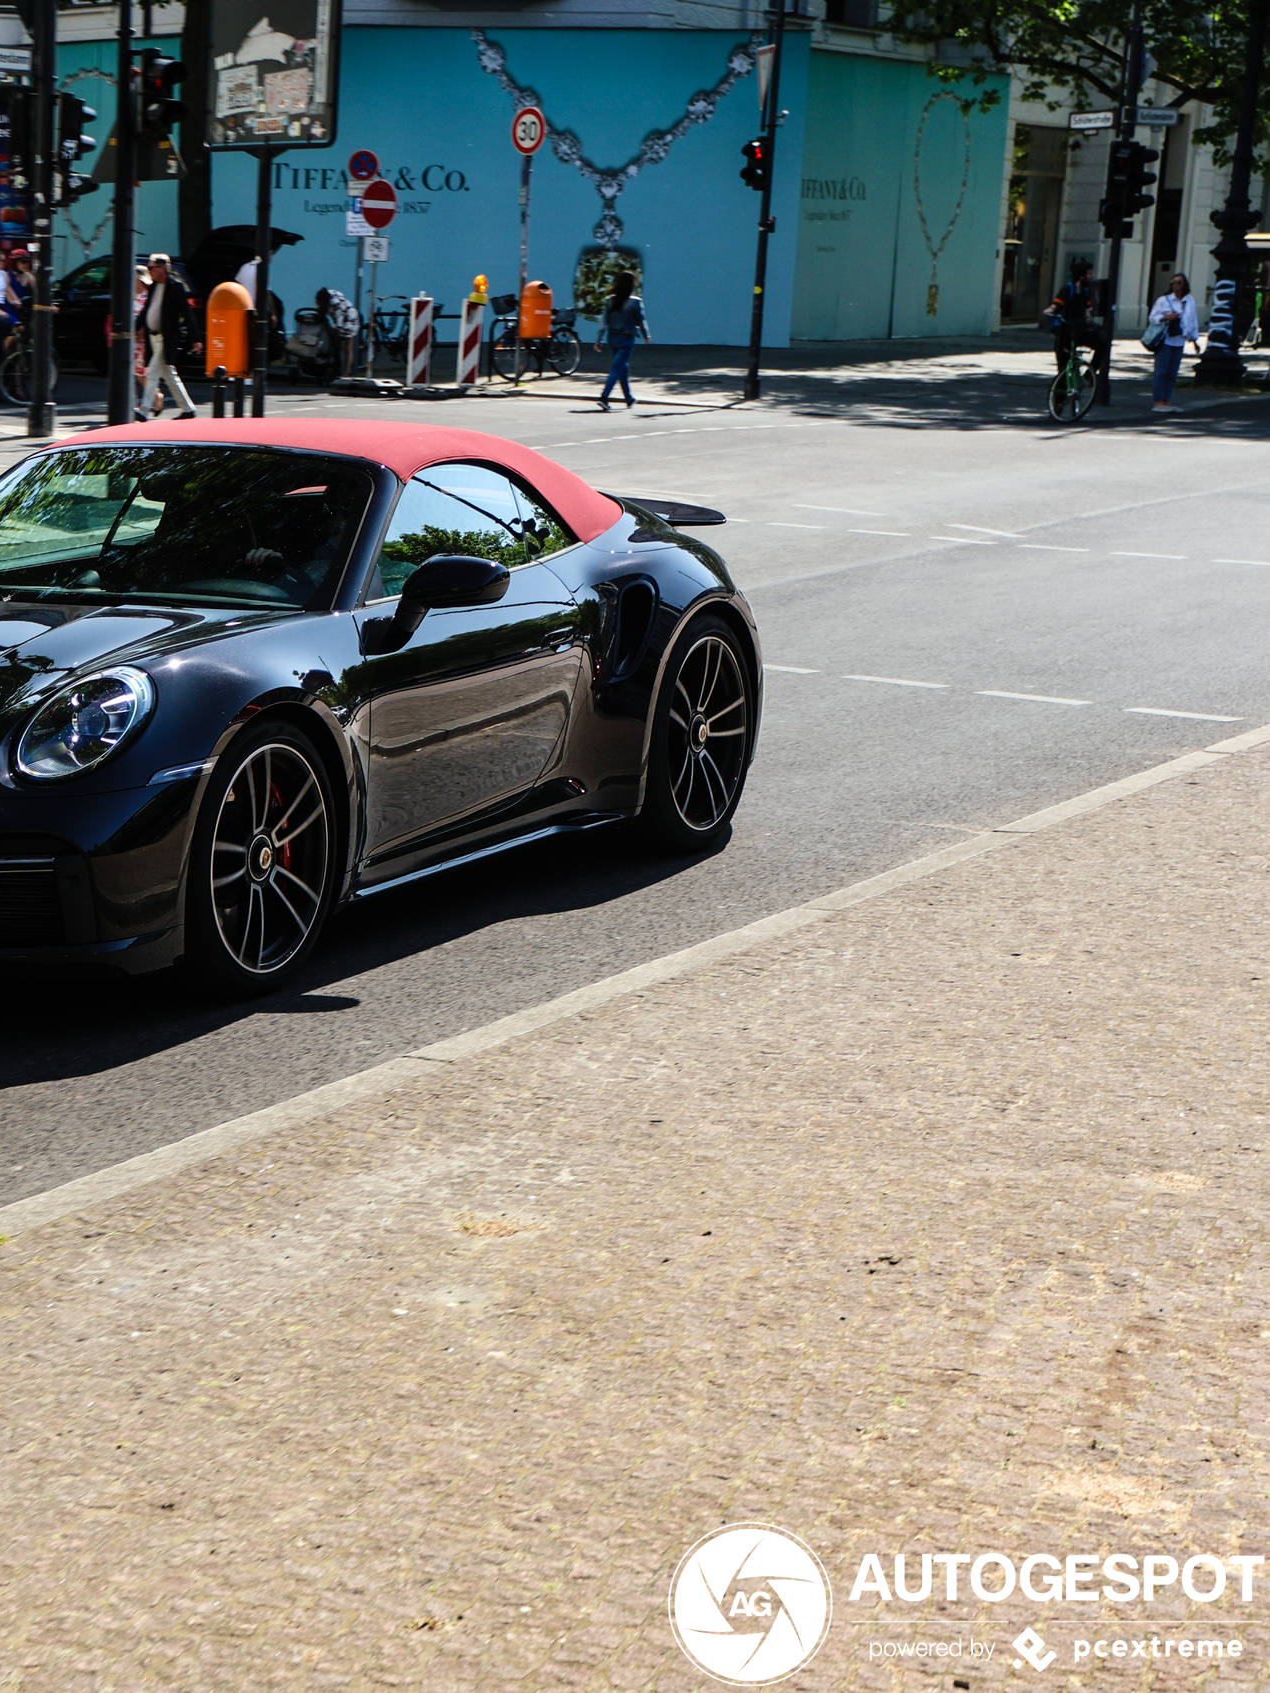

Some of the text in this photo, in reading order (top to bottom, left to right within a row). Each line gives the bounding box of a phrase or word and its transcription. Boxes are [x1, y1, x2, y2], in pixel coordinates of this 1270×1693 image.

[518, 121, 538, 141] 30
[394, 166, 416, 191] &
[421, 164, 470, 192] Co.
